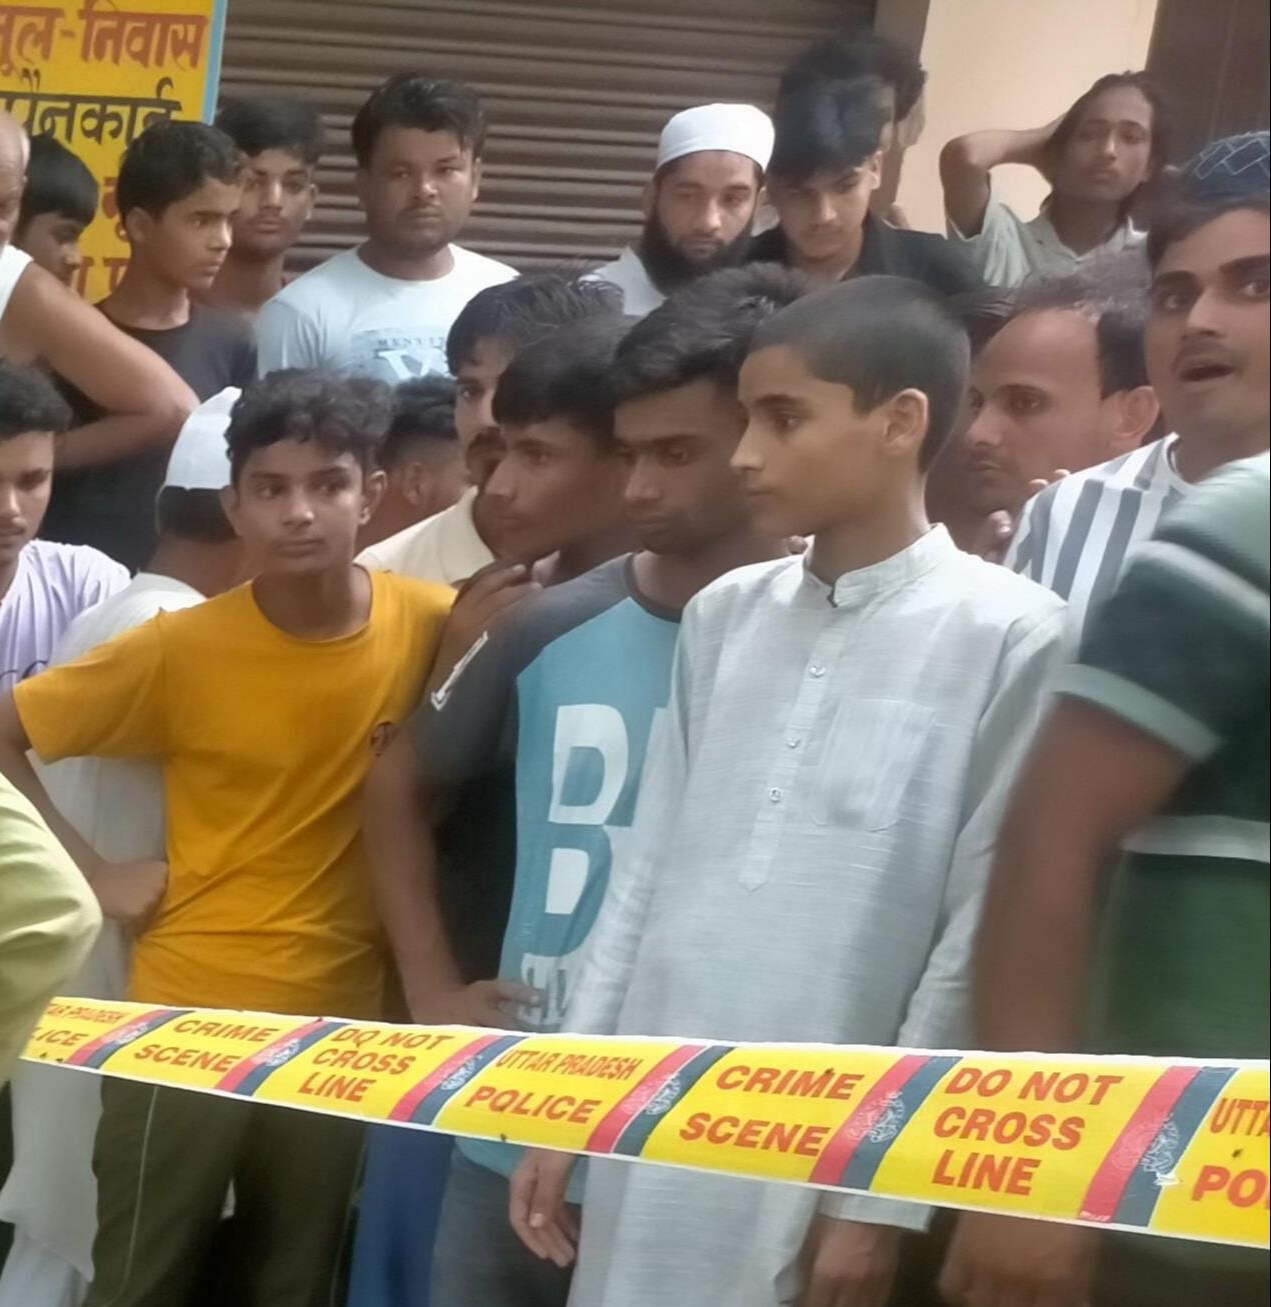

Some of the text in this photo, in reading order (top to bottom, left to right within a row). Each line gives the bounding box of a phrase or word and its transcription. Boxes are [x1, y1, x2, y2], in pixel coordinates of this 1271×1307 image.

[172, 1018, 281, 1044] CRIME
[331, 1027, 455, 1051] DO NOT
[134, 1043, 245, 1073] SCENE
[312, 1047, 417, 1076] CROSS
[496, 1049, 644, 1082] UTTAR PRADESH
[298, 1072, 377, 1103] LINE
[715, 1065, 865, 1101] CRIME
[945, 1066, 1124, 1106] DO NOT
[465, 1085, 603, 1125] POLICE
[678, 1112, 832, 1158] SCENE
[932, 1107, 1087, 1151] CROSS
[931, 1149, 1042, 1197] LINE
[1190, 1165, 1269, 1208] PO
